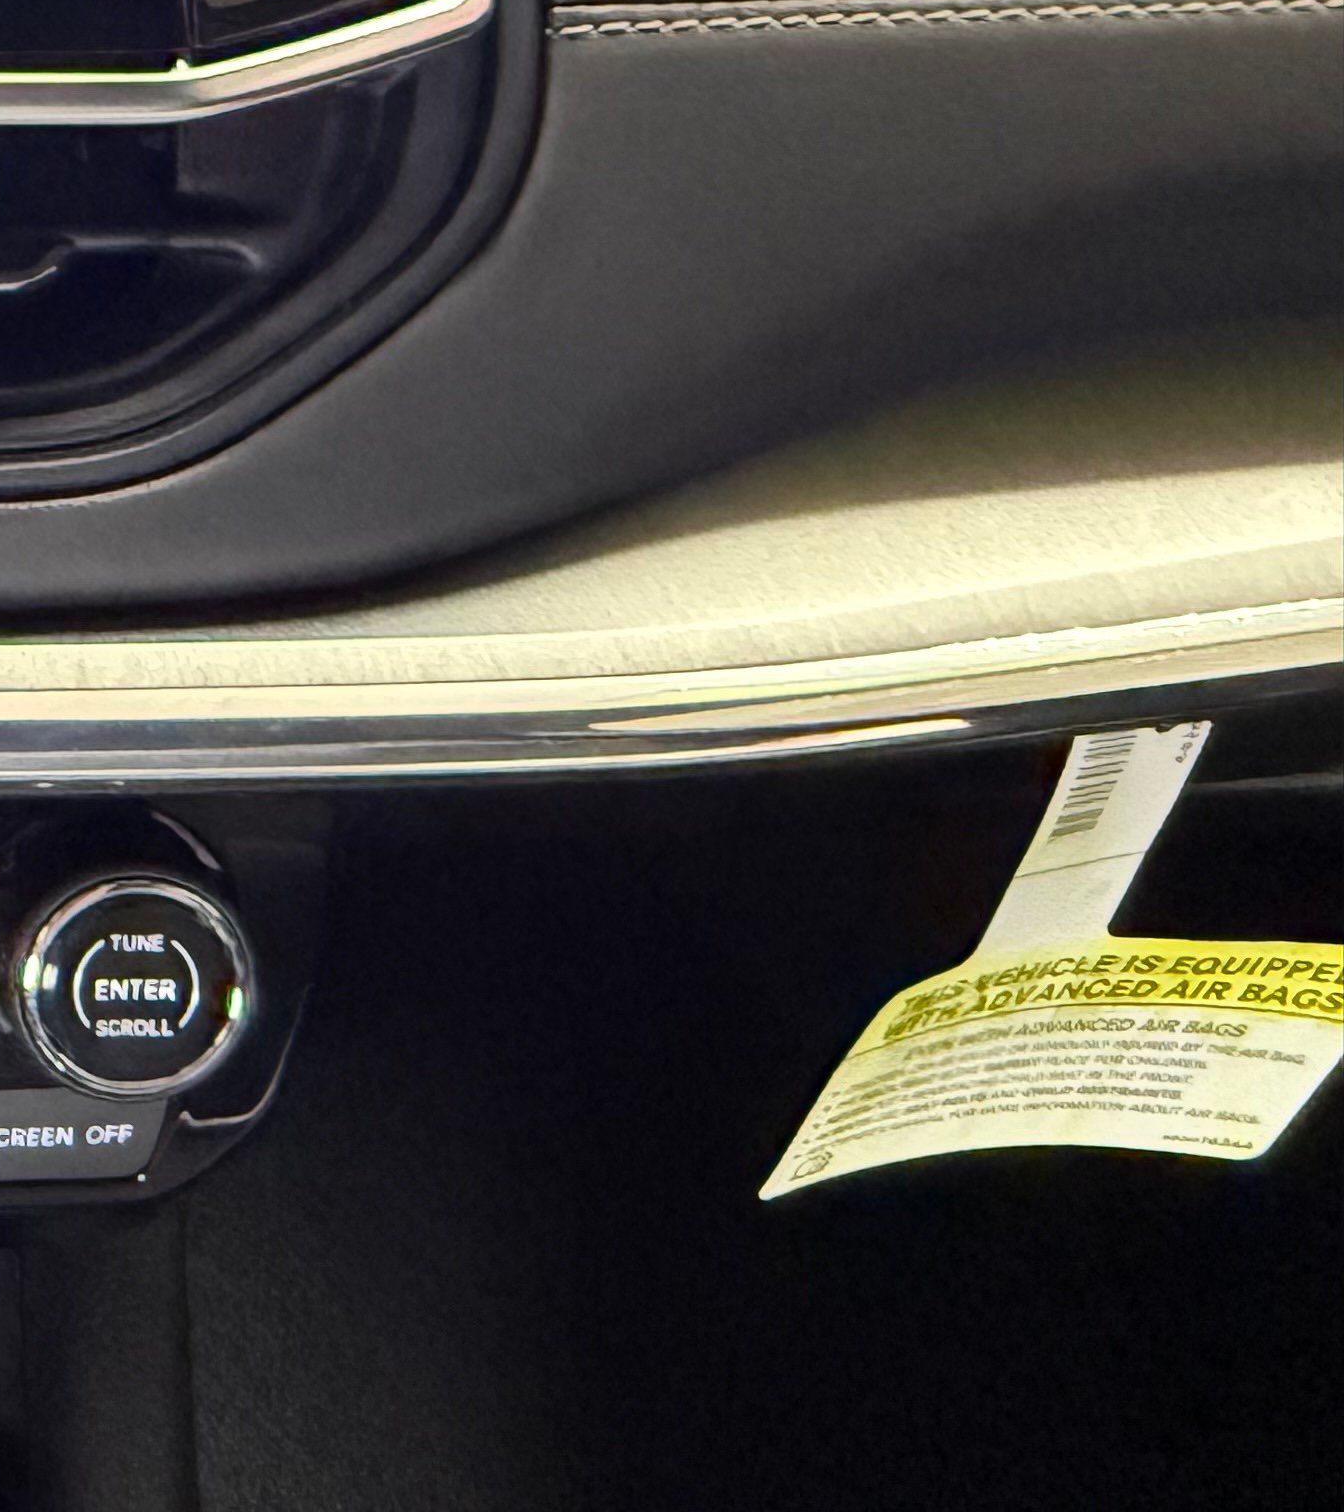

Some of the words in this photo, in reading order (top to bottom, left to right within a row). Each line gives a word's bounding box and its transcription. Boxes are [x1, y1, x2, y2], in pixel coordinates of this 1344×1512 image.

[110, 934, 164, 952] TUNE
[975, 955, 1119, 993] VEHICLE
[1120, 955, 1166, 974] IS
[1165, 956, 1344, 985] EQUIPPE
[95, 979, 176, 1001] ENTER
[962, 978, 1160, 1016] ADVANCED
[1160, 979, 1232, 1001] AIR
[1236, 982, 1344, 1013] BAGS
[95, 1019, 174, 1038] SCROLL
[86, 1124, 133, 1144] OFF
